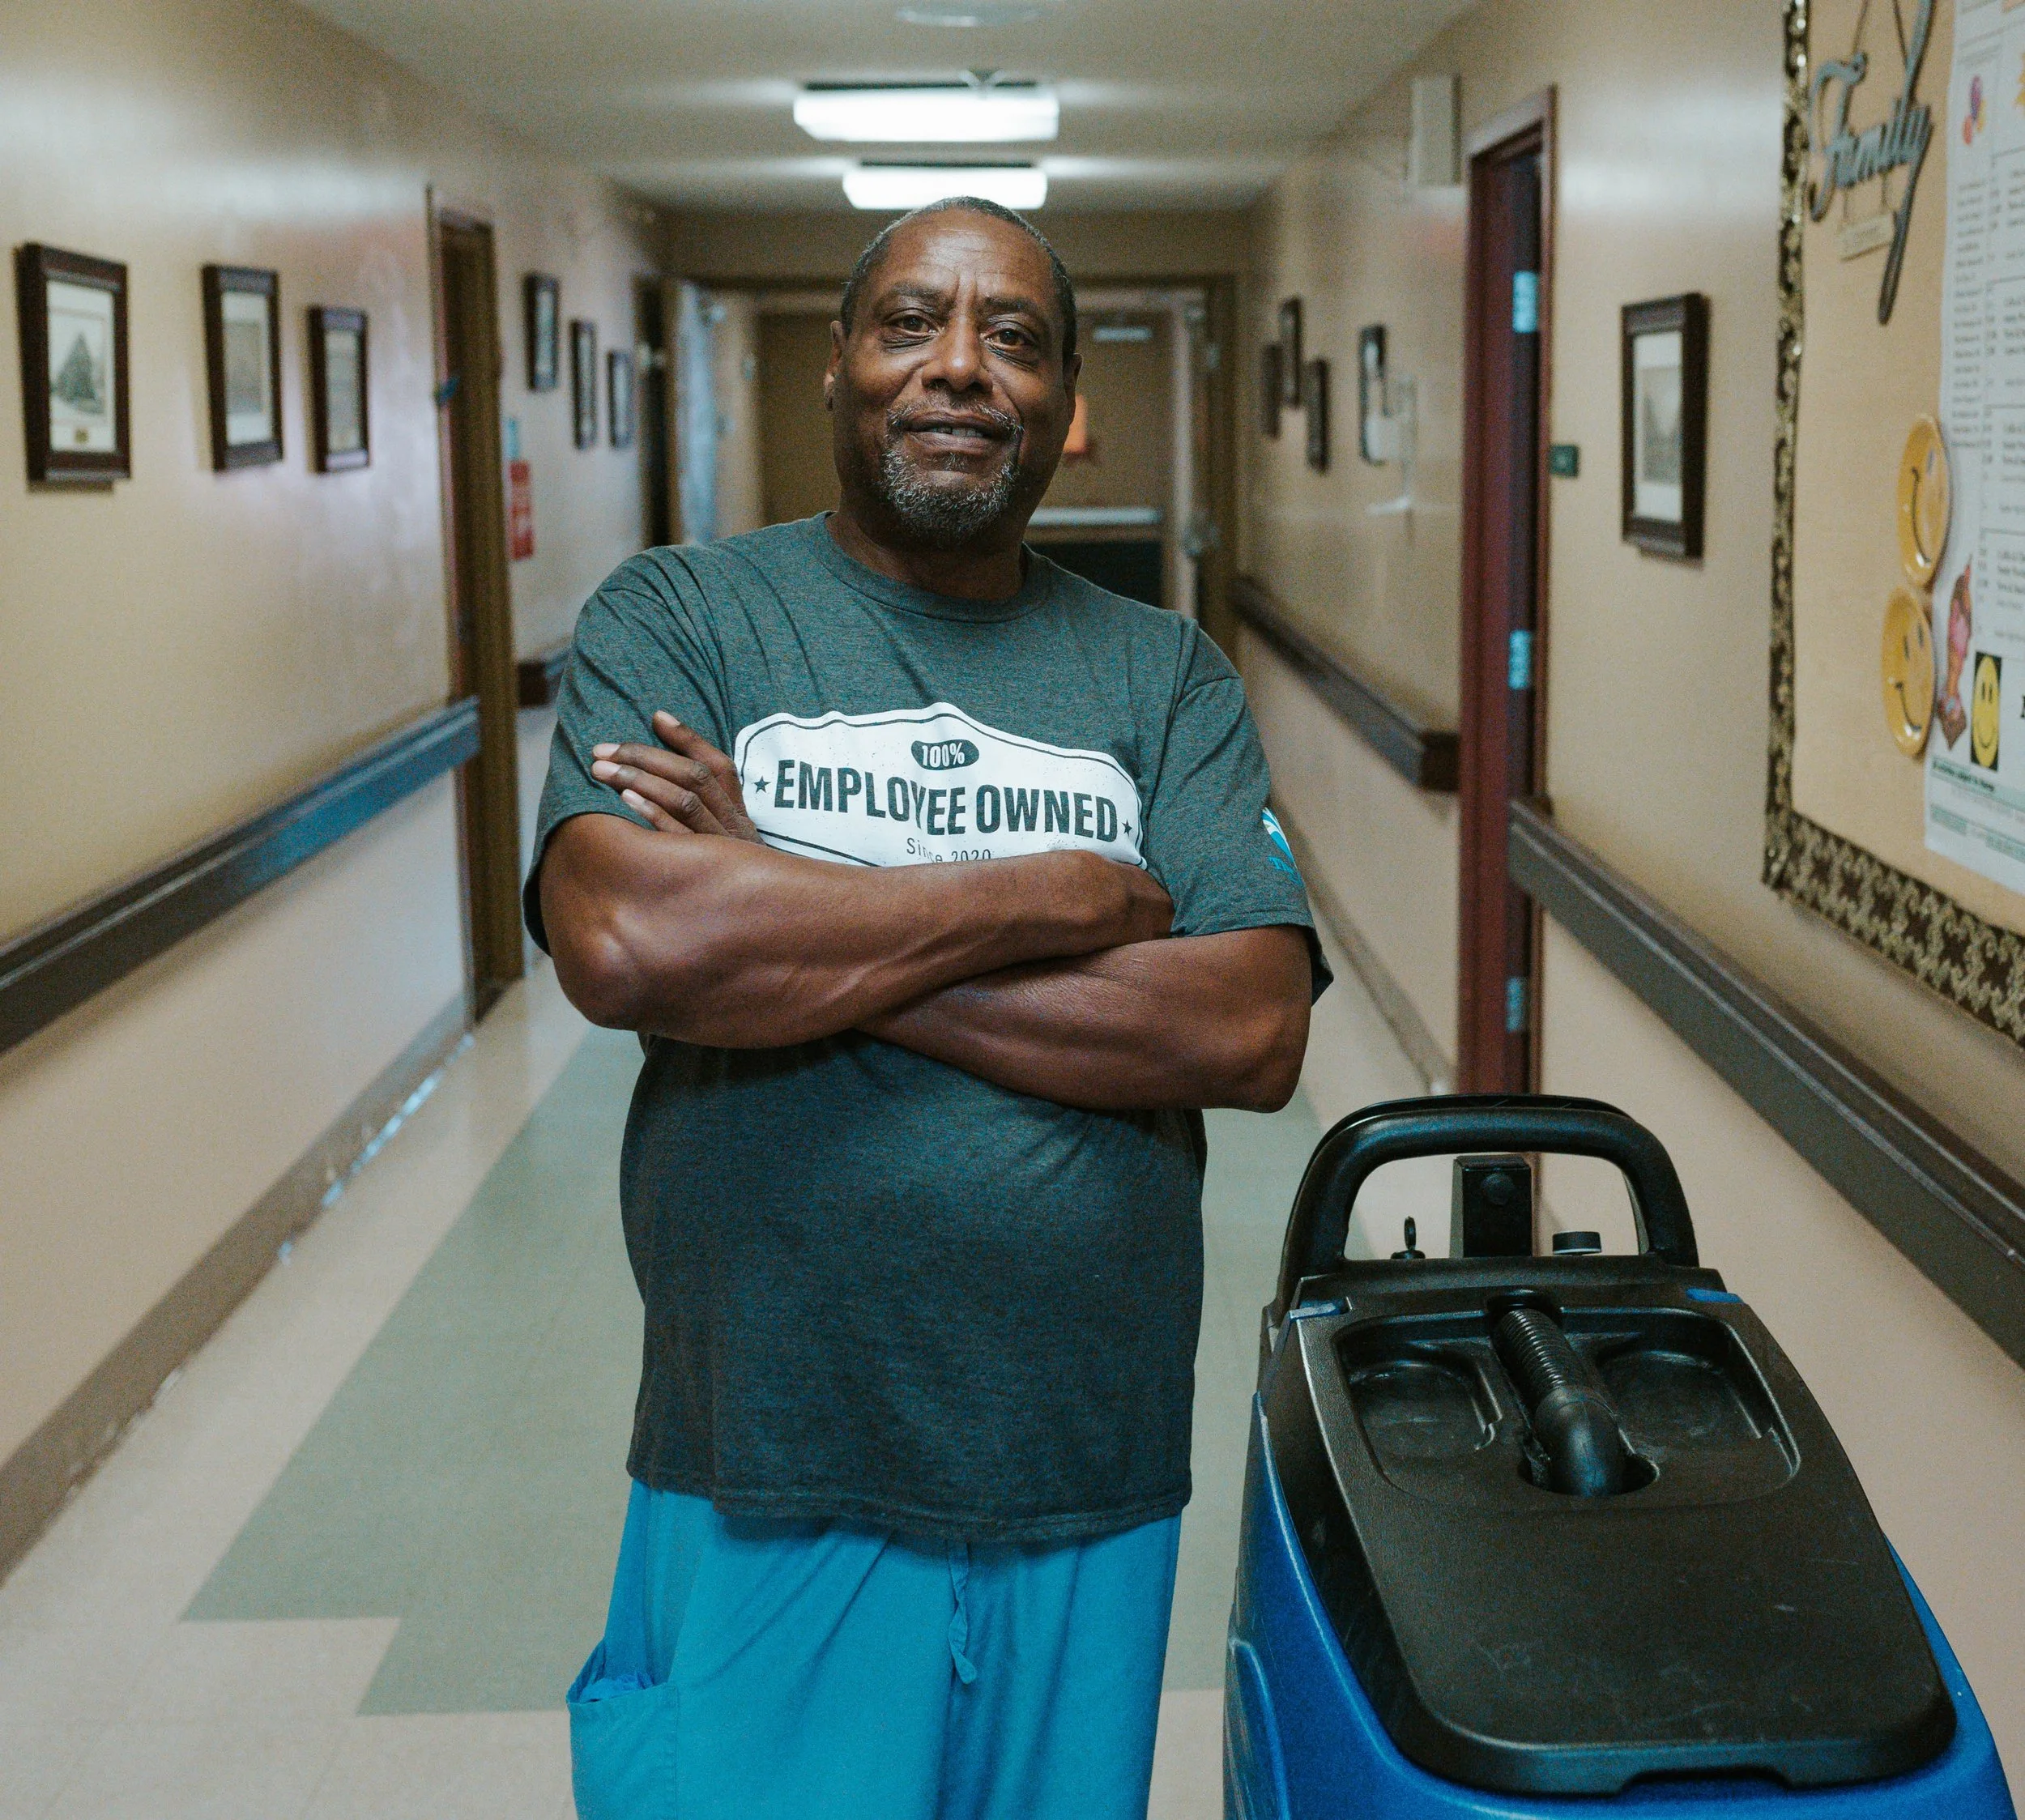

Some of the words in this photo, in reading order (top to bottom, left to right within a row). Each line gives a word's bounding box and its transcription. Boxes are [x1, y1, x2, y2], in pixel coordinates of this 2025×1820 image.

[922, 742, 966, 768] 100%
[774, 759, 966, 836] EMPLOYEE
[976, 784, 1118, 842] OWNED
[906, 838, 943, 863] Since
[951, 849, 991, 862] 2020
